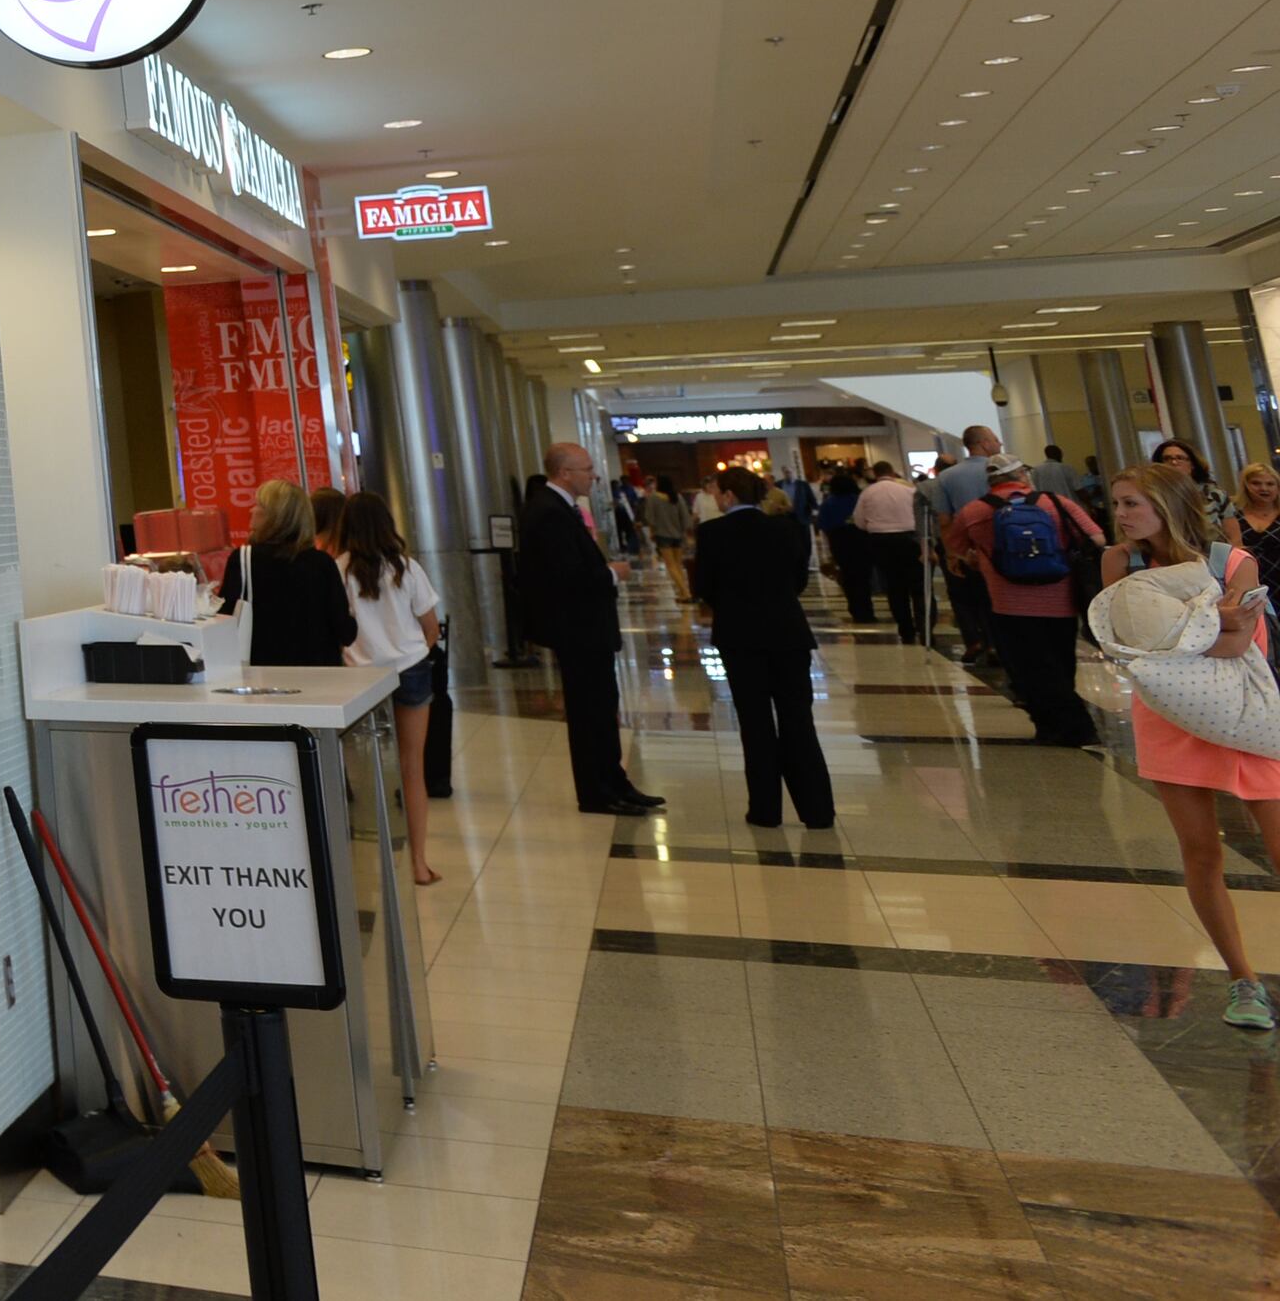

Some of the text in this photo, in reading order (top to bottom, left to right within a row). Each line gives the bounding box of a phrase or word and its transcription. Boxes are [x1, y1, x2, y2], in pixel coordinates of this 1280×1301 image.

[144, 54, 306, 229] FAMOUS FAMIGLIA
[365, 200, 481, 229] FAMIGLIA
[215, 417, 257, 508] garlic
[164, 819, 289, 830] smoothies yogurt
[164, 865, 309, 889] EXIT THANK
[212, 908, 266, 929] YOU
